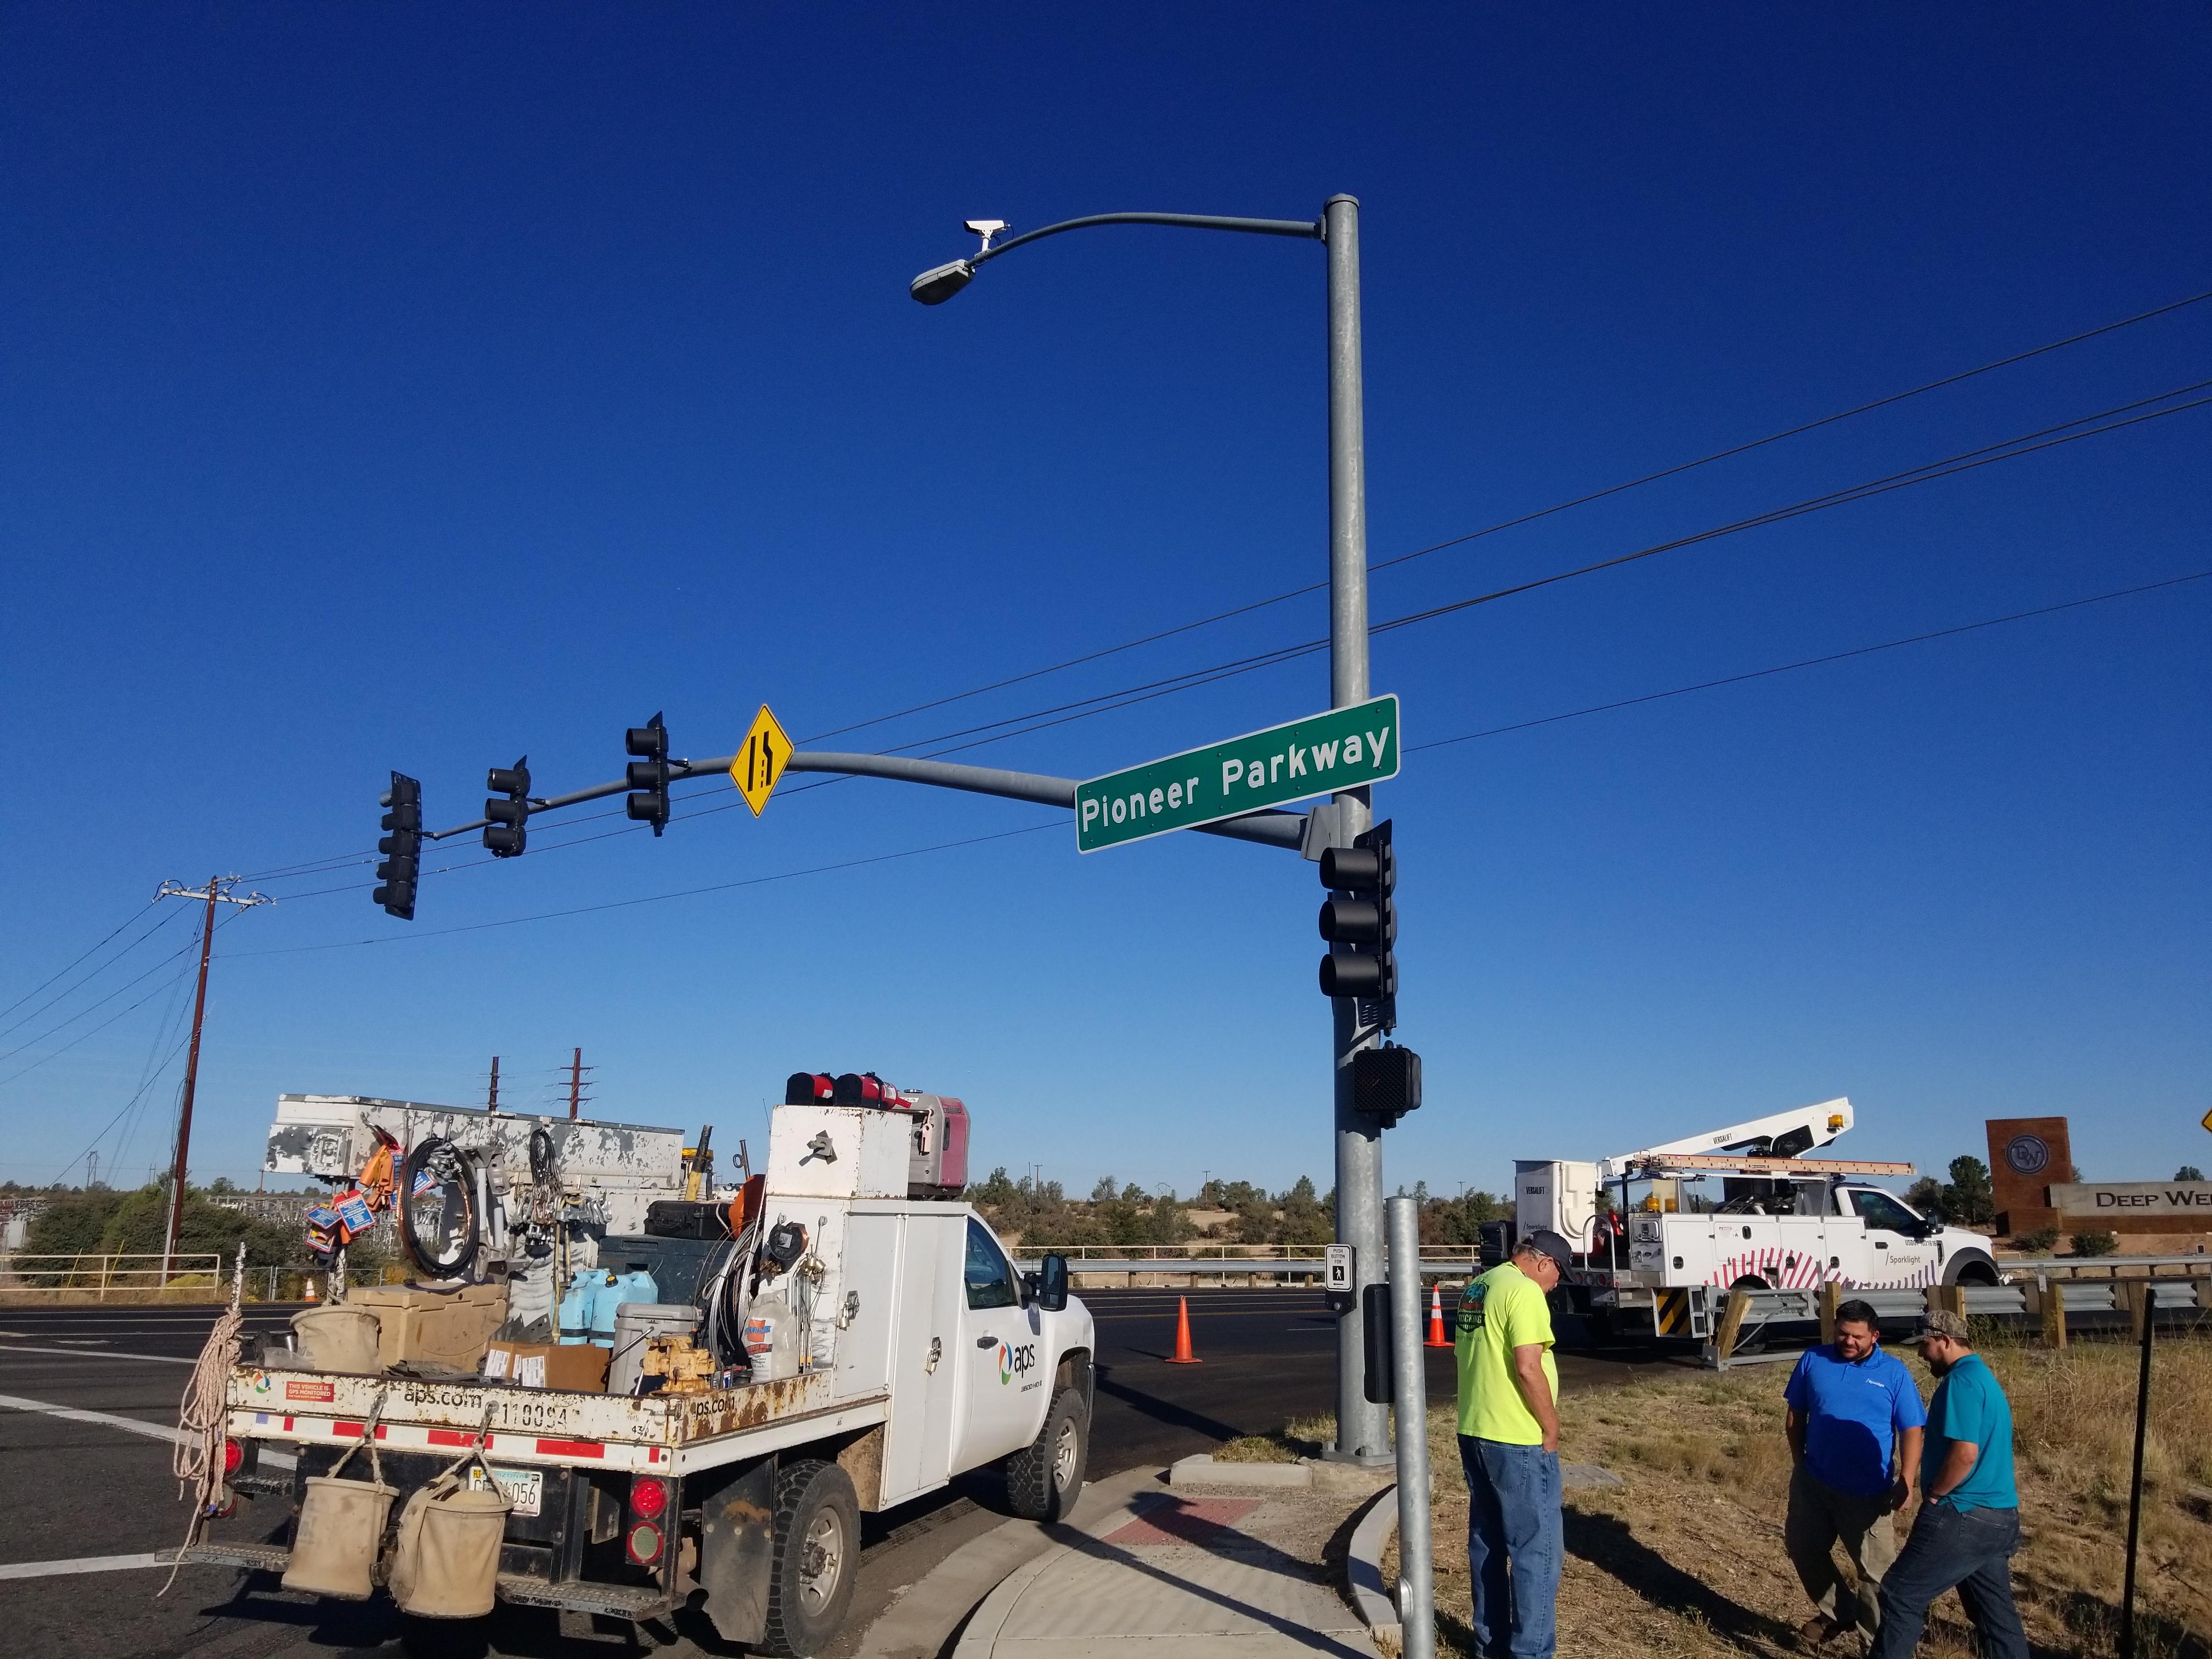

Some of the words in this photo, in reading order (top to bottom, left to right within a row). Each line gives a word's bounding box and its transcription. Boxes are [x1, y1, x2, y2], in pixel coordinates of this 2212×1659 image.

[1082, 776, 1200, 833] Pioneer
[1222, 727, 1390, 795] Parkway
[1713, 1133, 1733, 1144] VERSALIFT
[1526, 1186, 1544, 1194] VERSALIFT
[1889, 1255, 1921, 1266] Sparklight
[1458, 1314, 1482, 1324] RUCKING
[1014, 1344, 1035, 1379] aps
[404, 1389, 482, 1409] aps.com
[694, 1397, 735, 1420] ps.com
